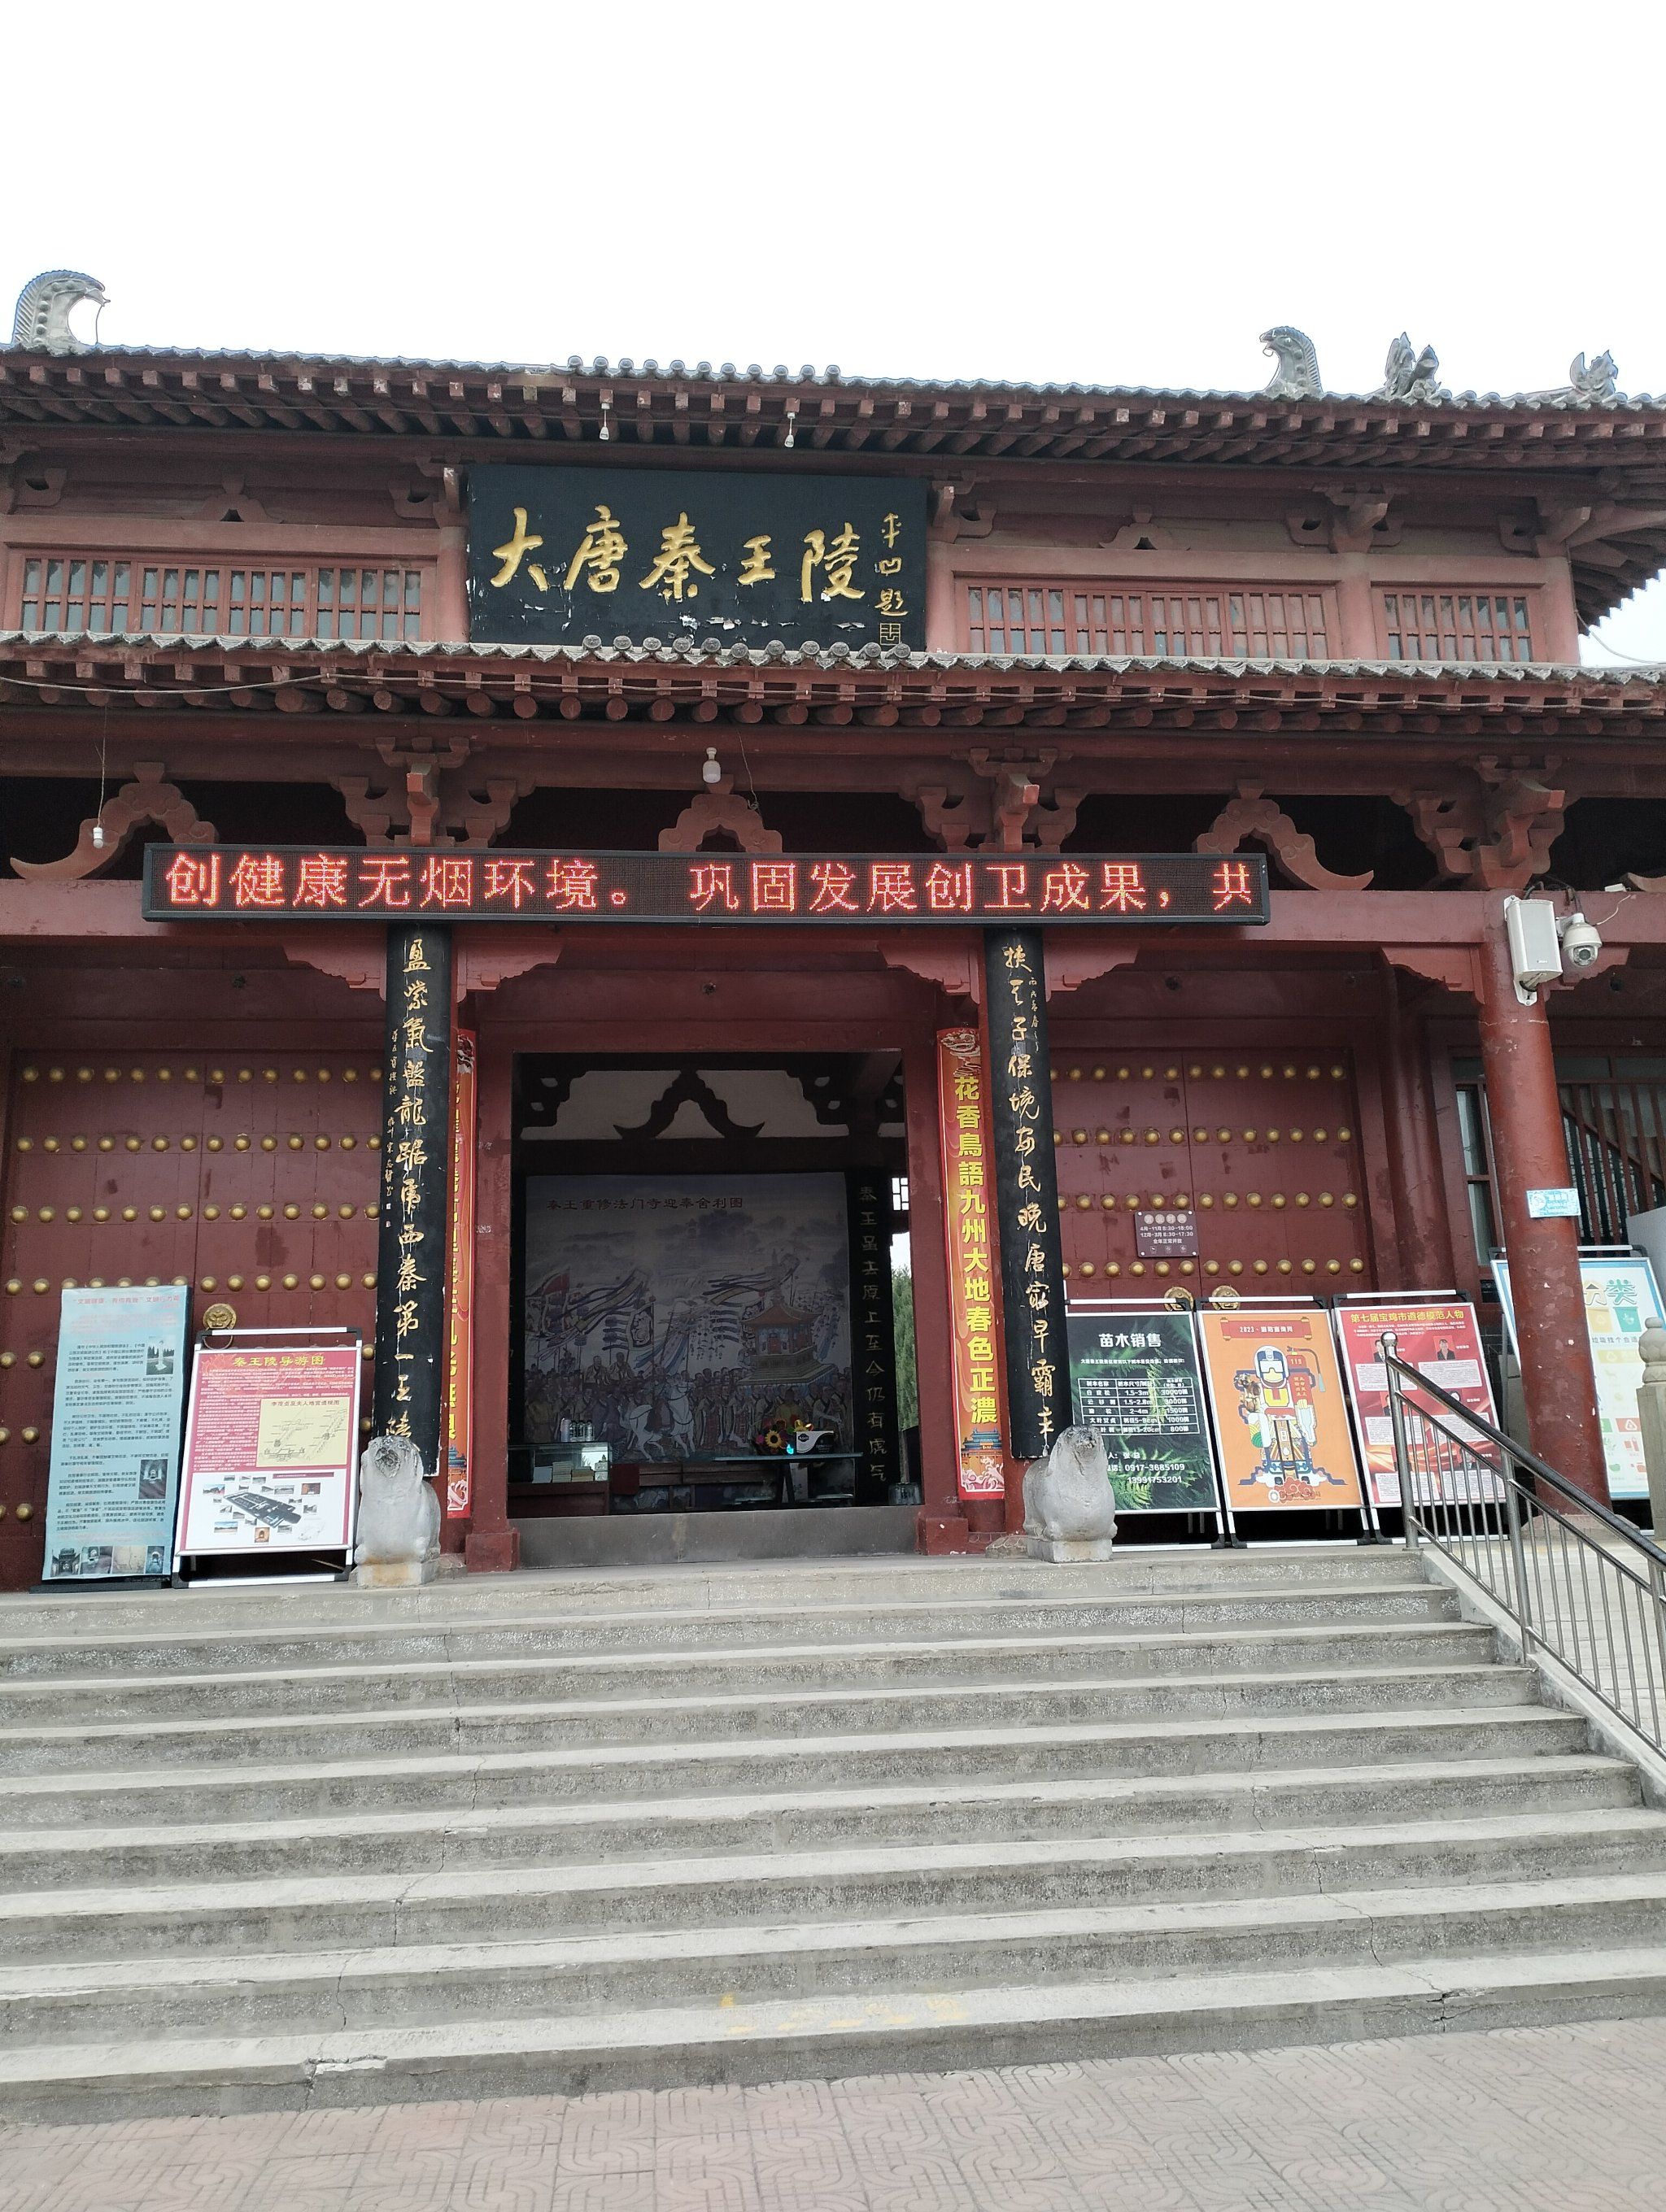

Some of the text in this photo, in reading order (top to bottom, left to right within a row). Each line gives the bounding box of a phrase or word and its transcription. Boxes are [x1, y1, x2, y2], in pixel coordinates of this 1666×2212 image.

[490, 504, 866, 603] 大唐秦王陵
[547, 1197, 744, 1210] 秦王重修法门寺迎奉舍利图
[953, 1075, 998, 1424] 花香鳥語九州大地春色正濃
[1350, 1308, 1464, 1323] 第七届宝鸡市道德模范人物
[1098, 1332, 1162, 1348] 苗木销售
[233, 1355, 325, 1368] 秦王陵导游图
